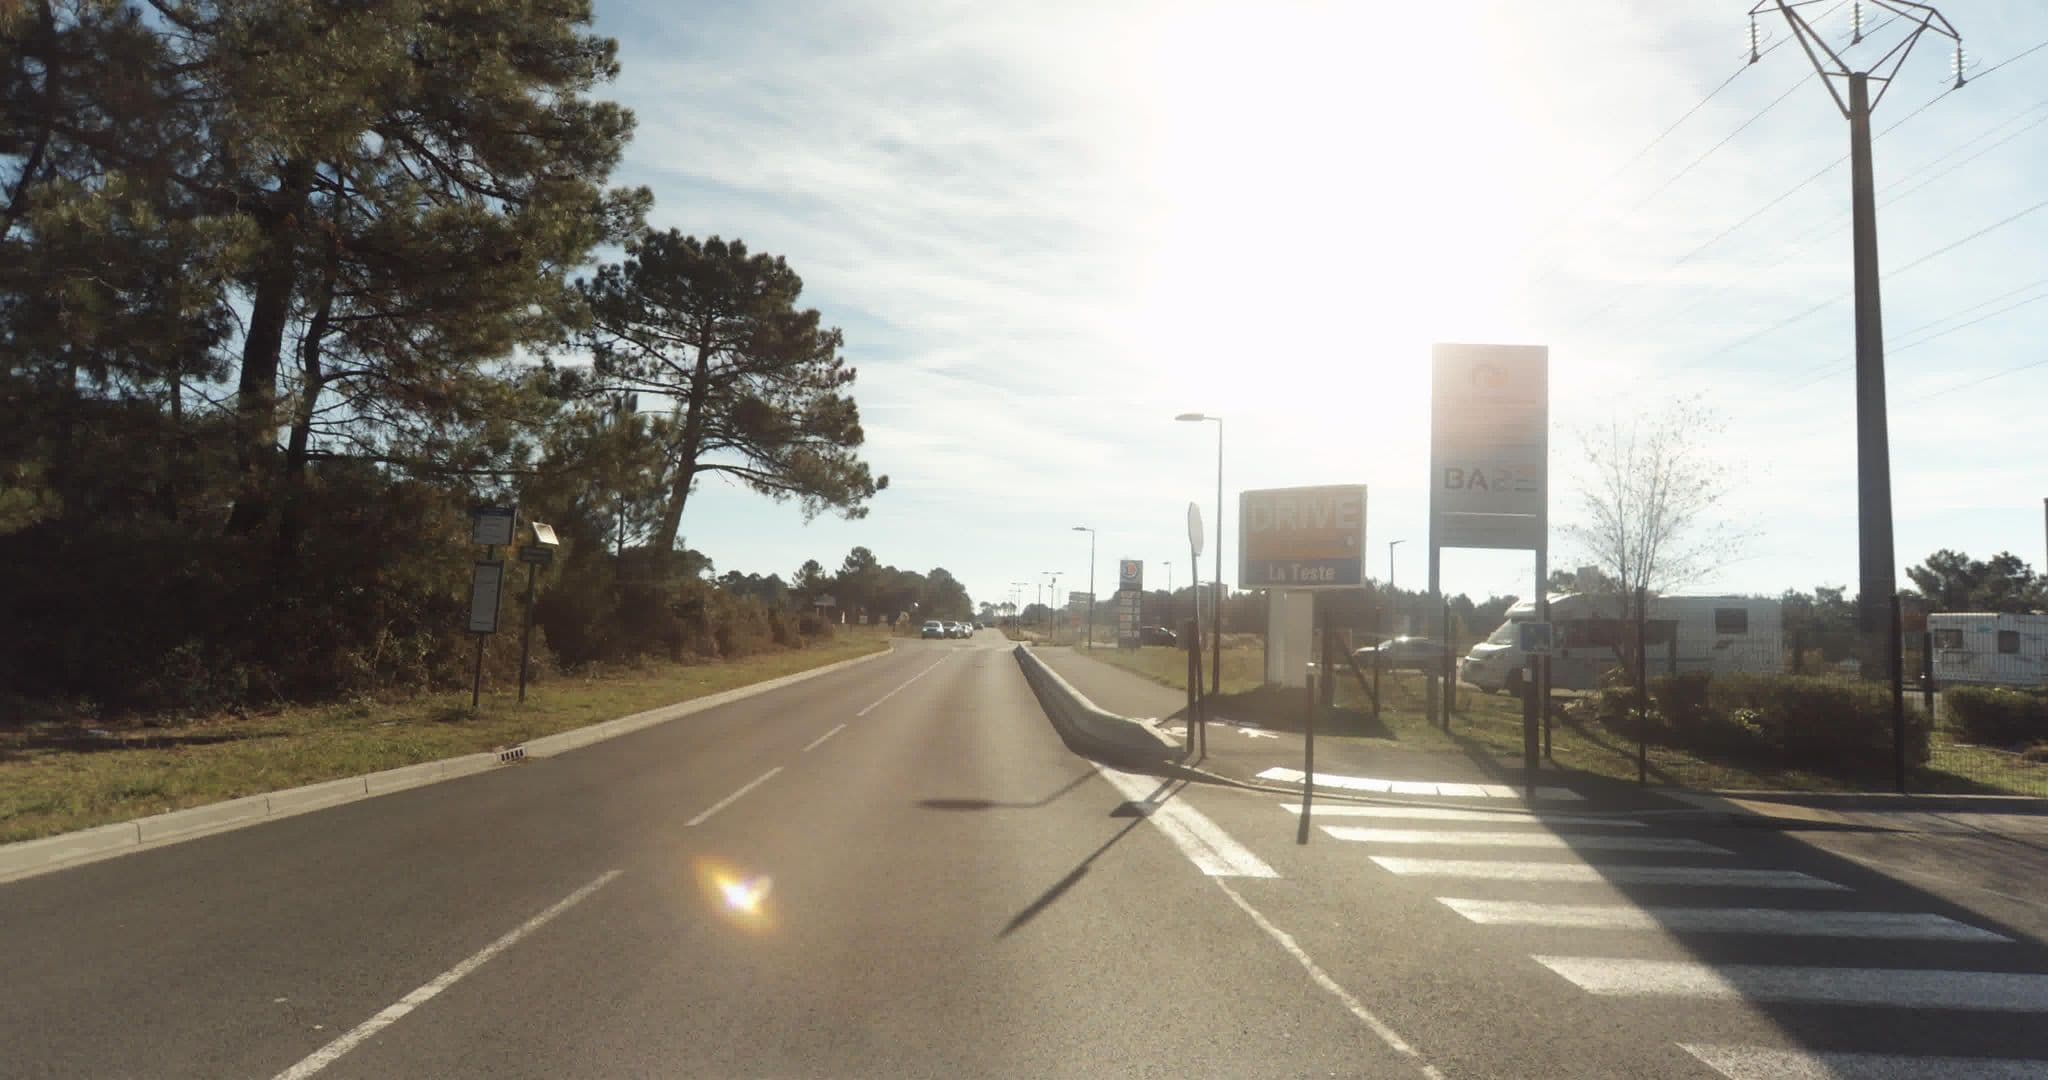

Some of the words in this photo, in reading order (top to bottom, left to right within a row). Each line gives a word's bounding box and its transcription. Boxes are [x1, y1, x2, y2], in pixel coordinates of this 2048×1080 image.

[1249, 495, 1361, 531] DRIVE
[1269, 562, 1286, 581] La
[1291, 562, 1337, 581] Teste
